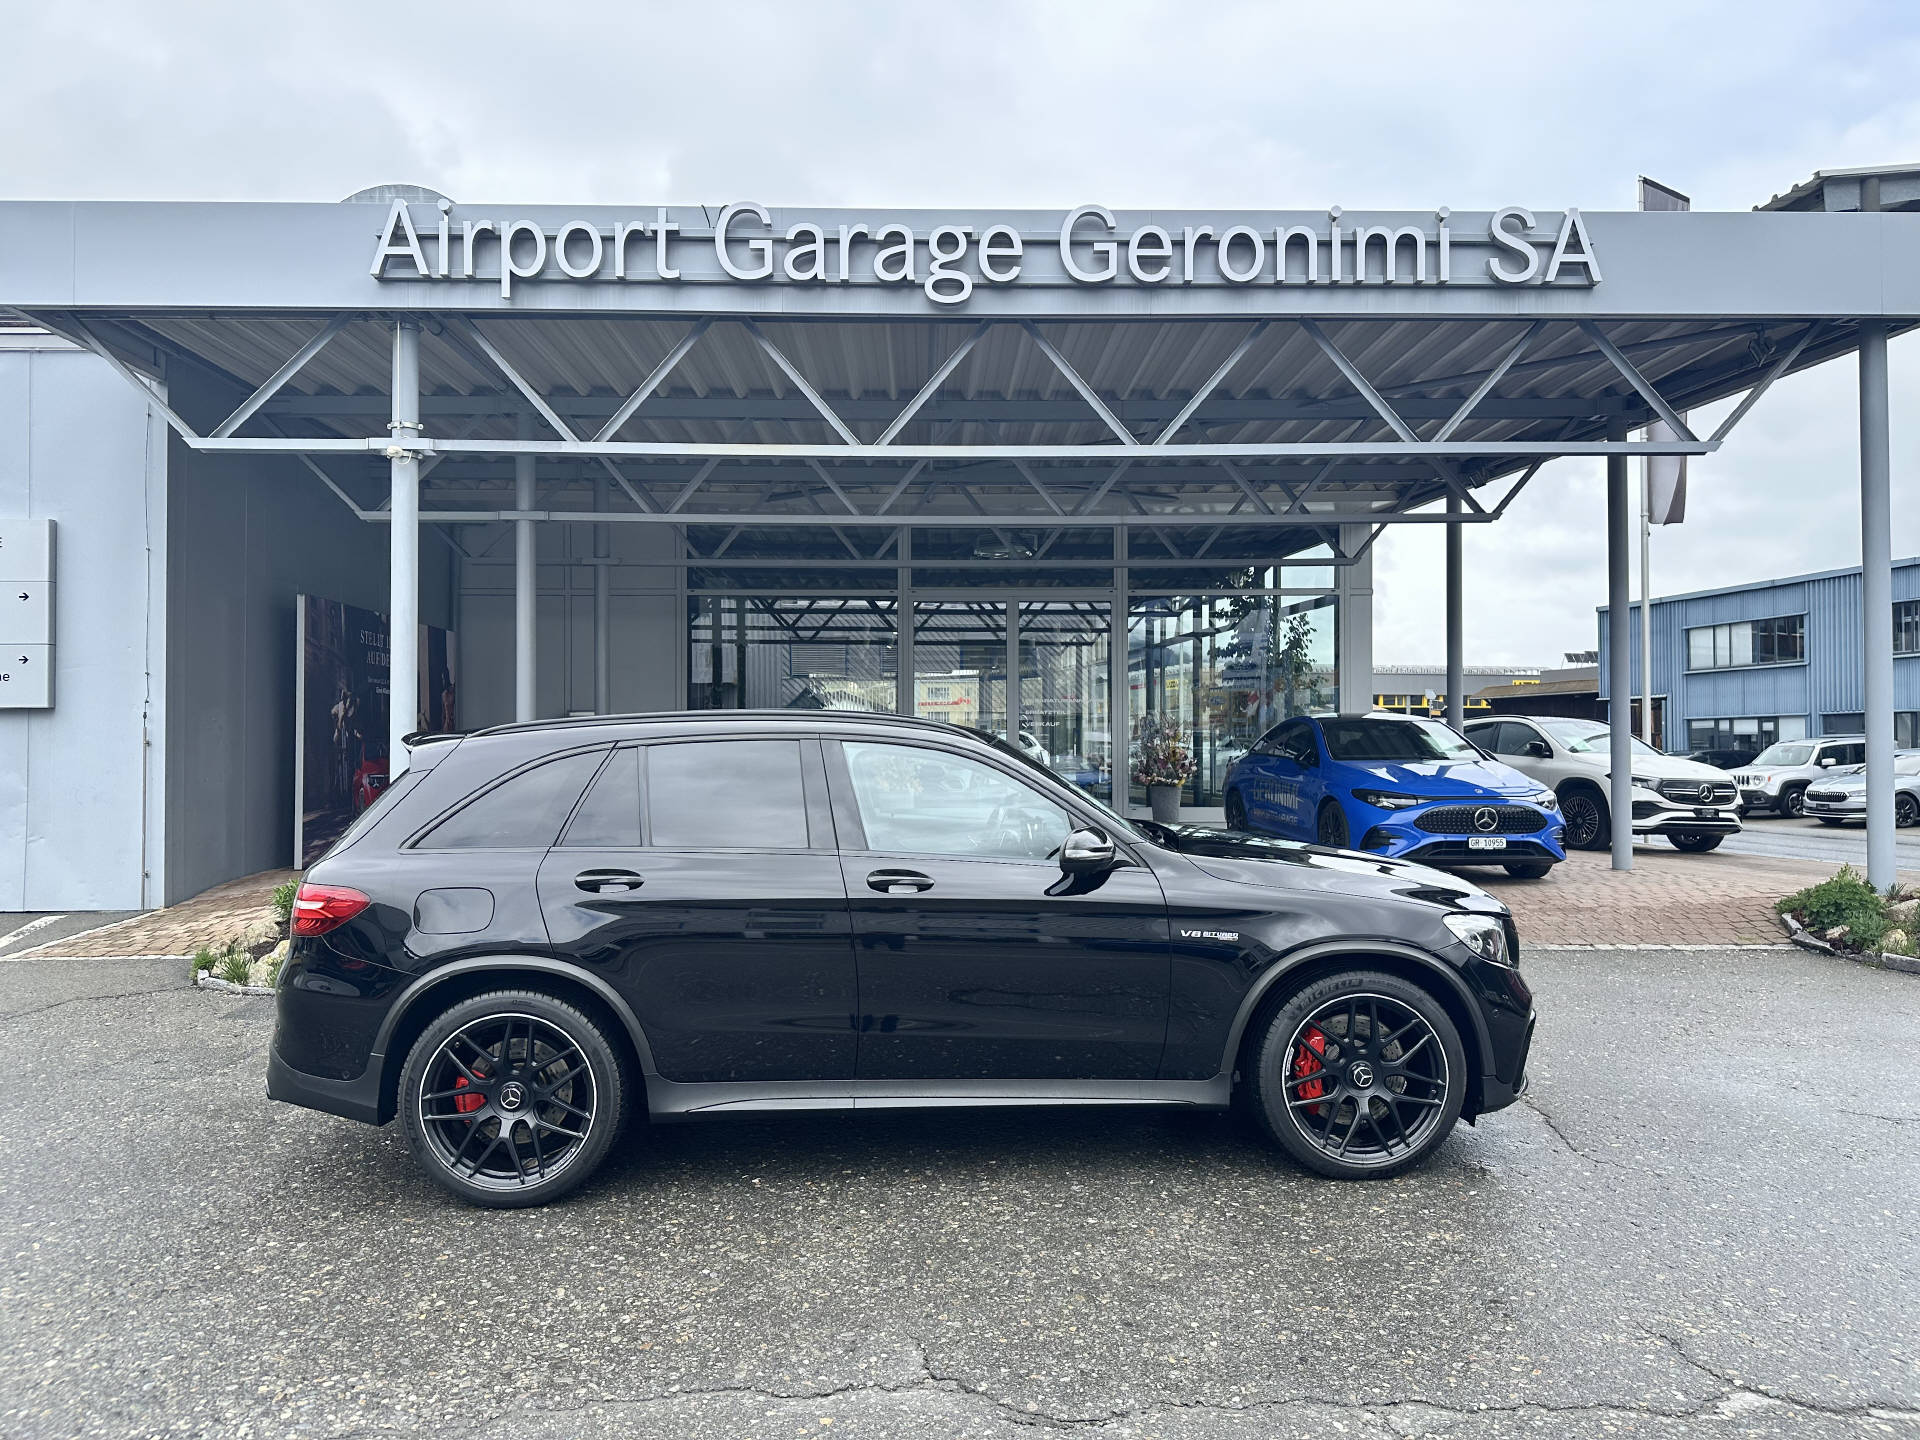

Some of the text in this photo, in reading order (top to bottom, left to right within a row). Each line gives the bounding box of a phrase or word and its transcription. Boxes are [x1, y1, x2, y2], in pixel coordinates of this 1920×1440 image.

[369, 198, 1603, 306] Airport Garage Geronimi SA
[1470, 838, 1504, 847] GR 10955
[1180, 929, 1202, 938] V8
